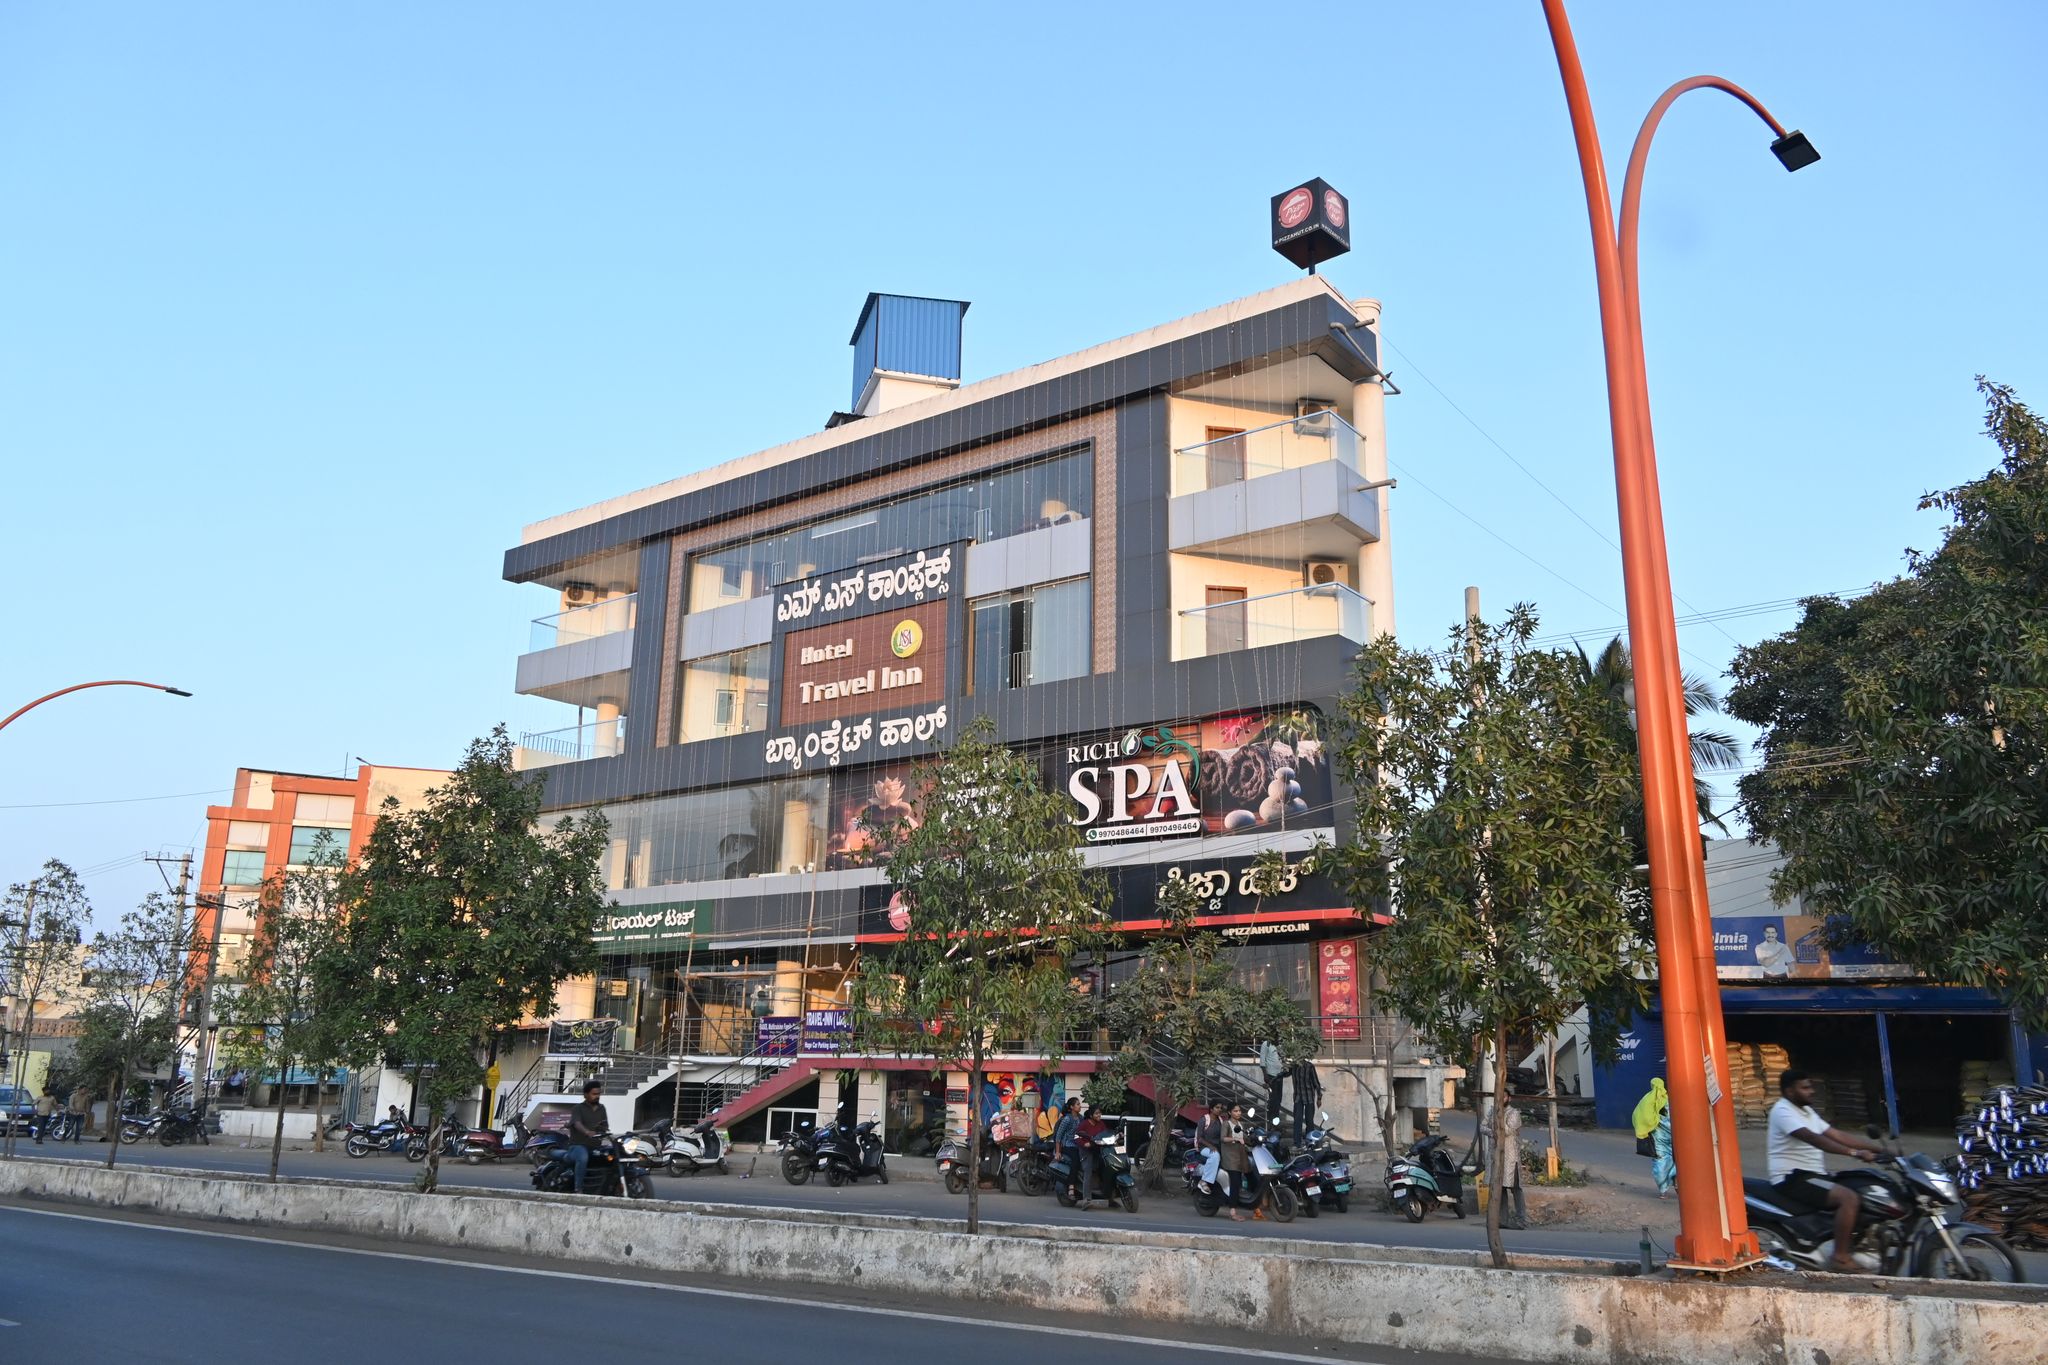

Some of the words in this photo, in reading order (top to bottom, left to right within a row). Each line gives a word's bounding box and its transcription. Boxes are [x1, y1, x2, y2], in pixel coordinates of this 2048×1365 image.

[800, 638, 852, 665] Hotel
[799, 669, 875, 704] Travel
[881, 666, 923, 690] Inn
[879, 705, 947, 747] ಹಾಲ್
[1066, 740, 1121, 764] RICH
[1067, 759, 1200, 826] SPA
[1228, 923, 1310, 936] PIZZAHUT.CO.IN
[1712, 931, 1748, 944] lmia
